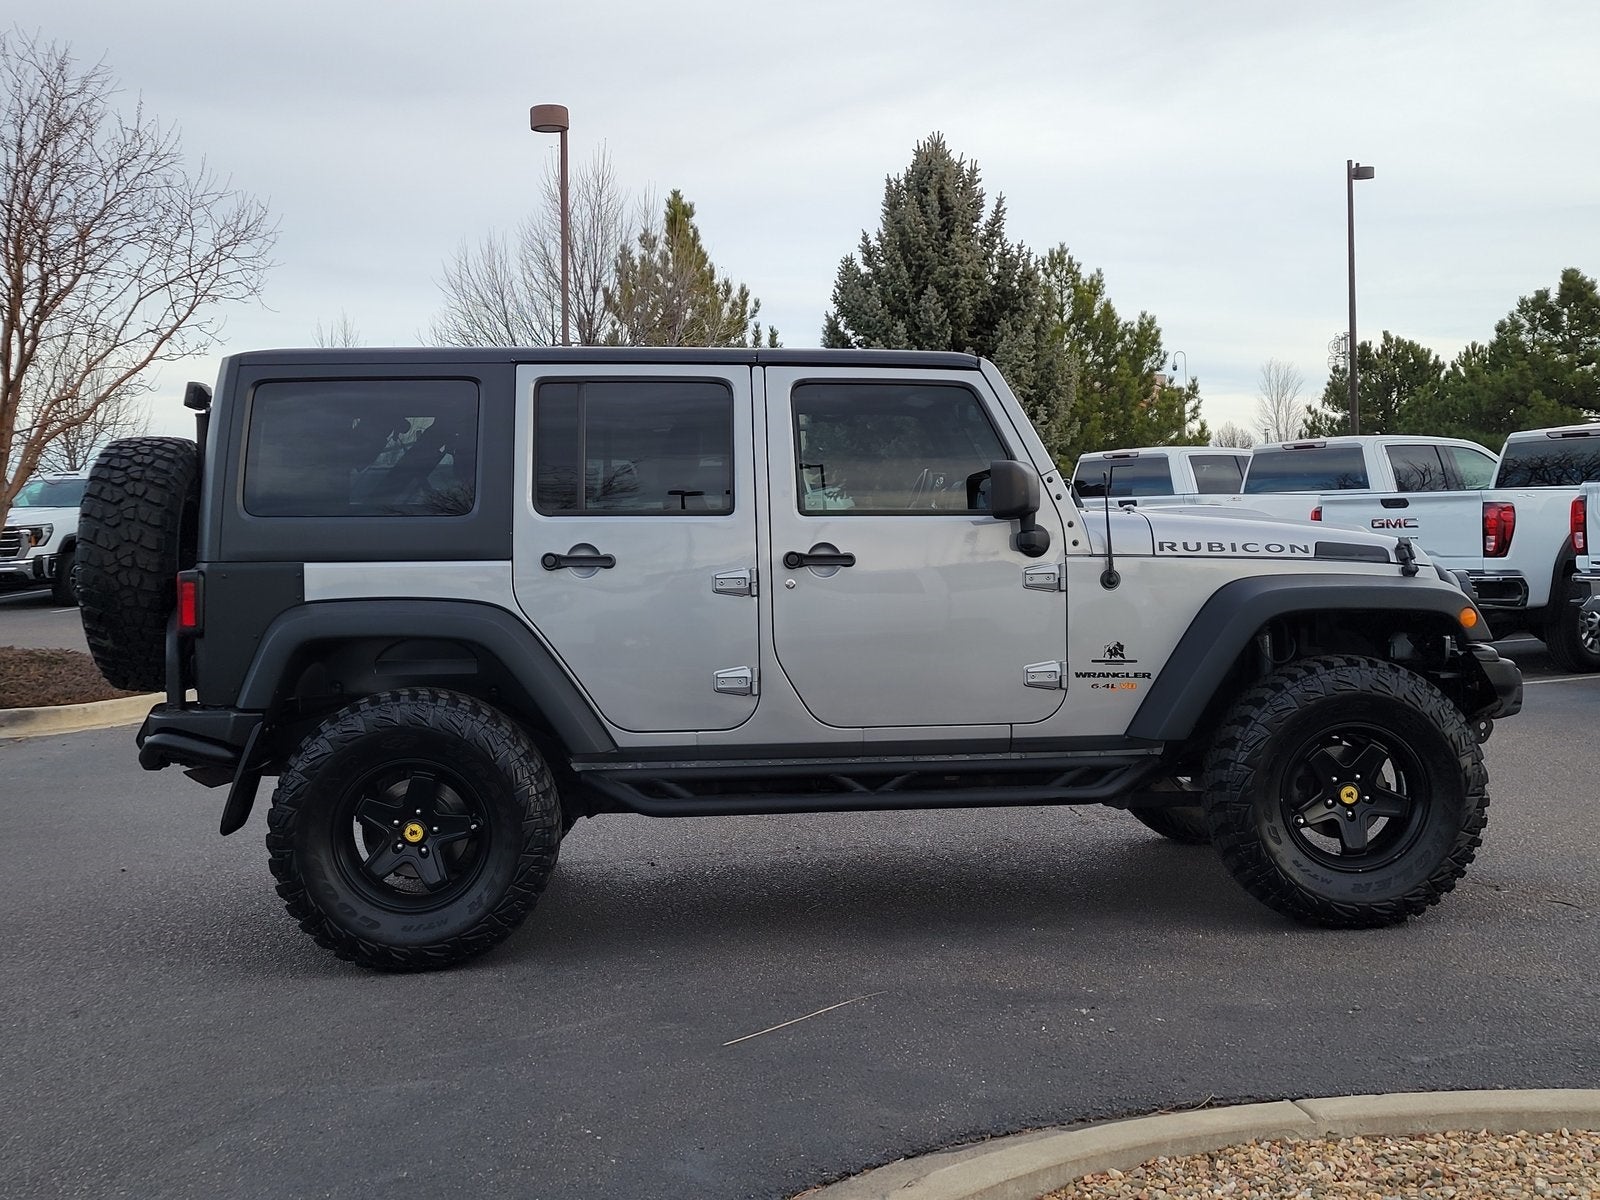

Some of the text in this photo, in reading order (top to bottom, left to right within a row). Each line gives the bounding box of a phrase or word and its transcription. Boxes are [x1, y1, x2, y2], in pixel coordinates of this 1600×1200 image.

[1371, 518, 1419, 529] GMC
[1158, 541, 1310, 554] RUBICON
[1074, 671, 1152, 680] WRANGLER
